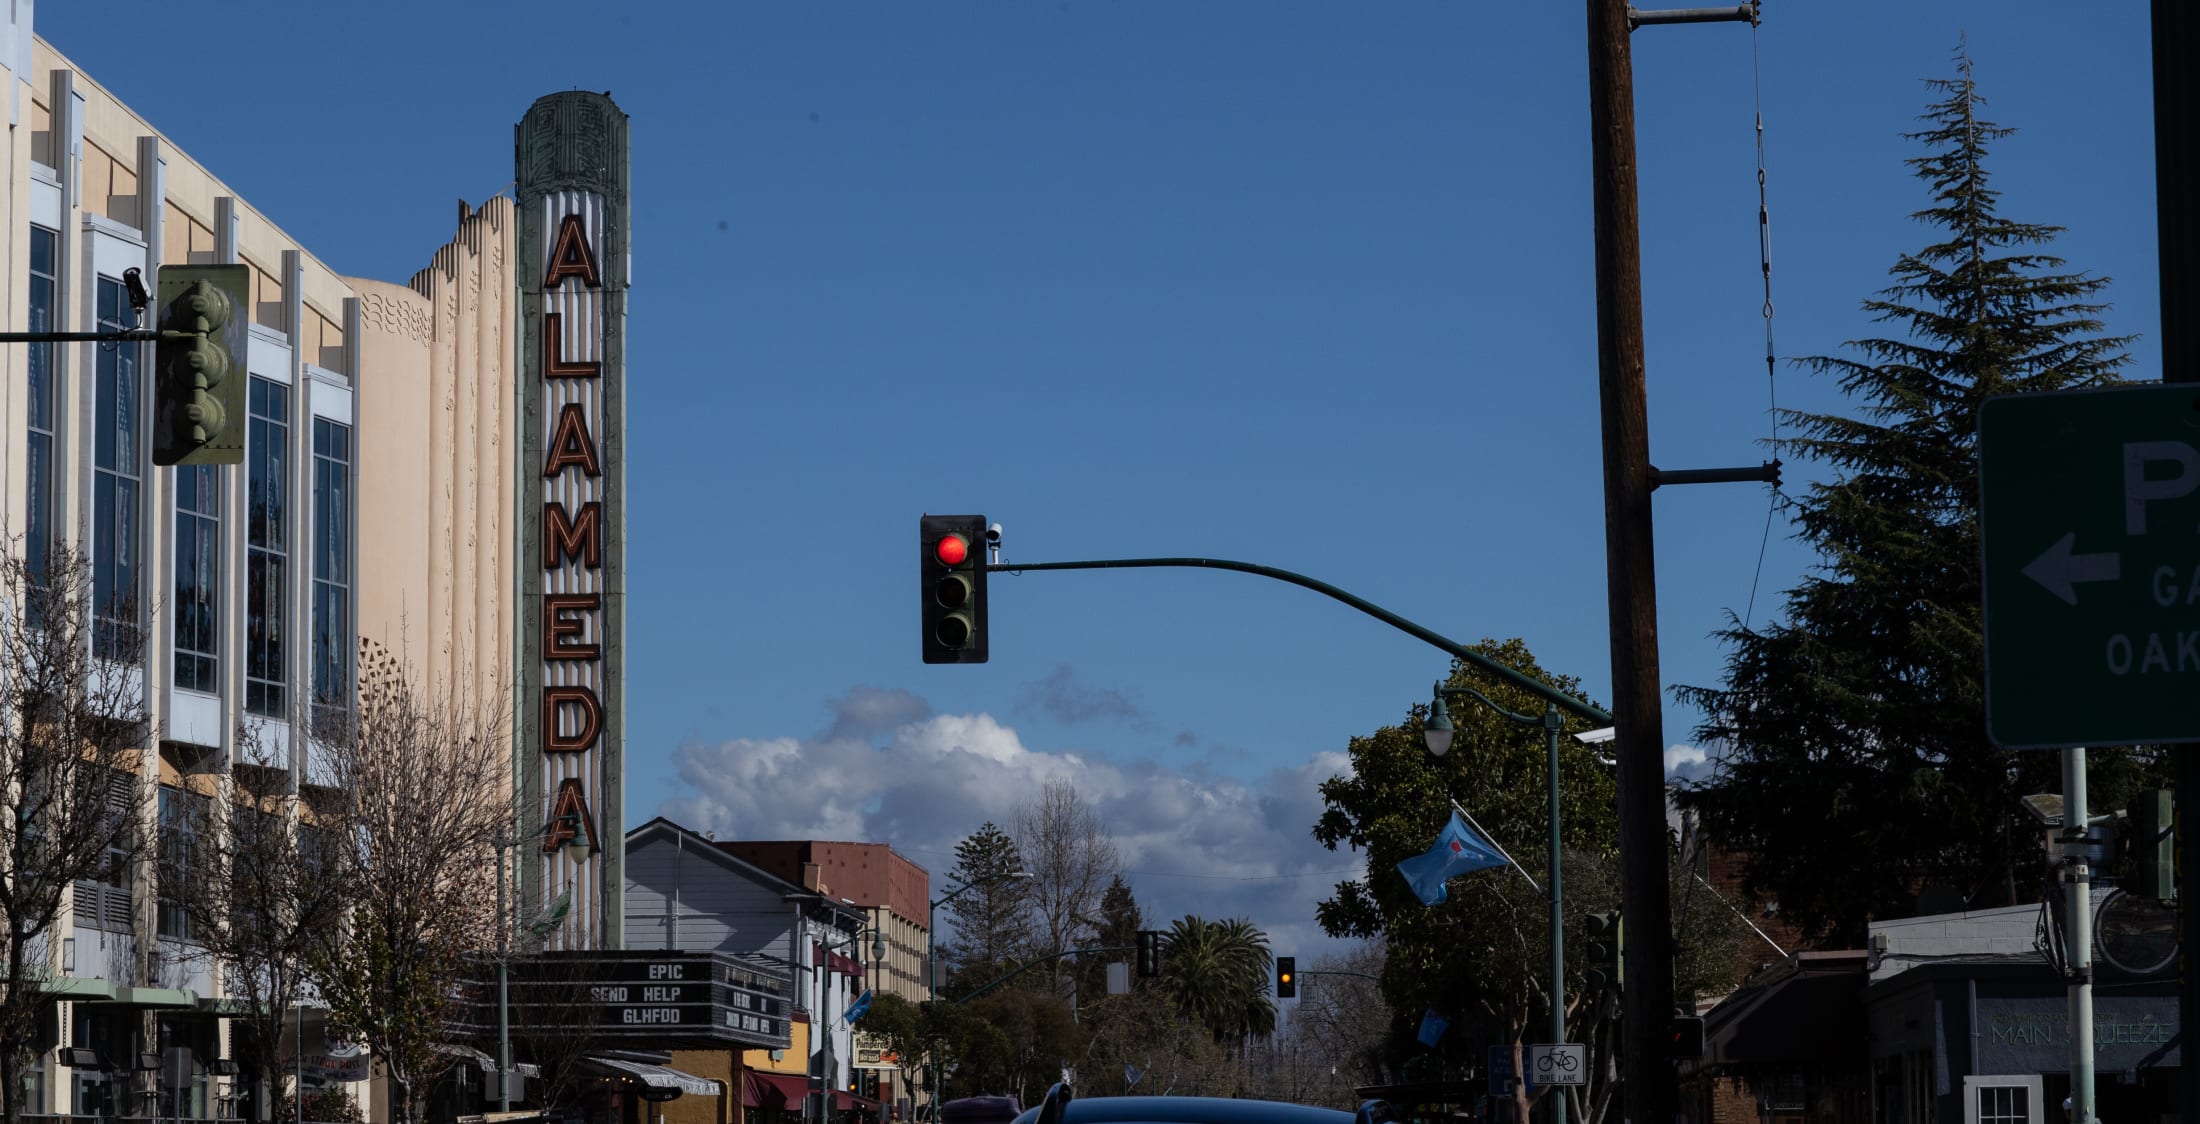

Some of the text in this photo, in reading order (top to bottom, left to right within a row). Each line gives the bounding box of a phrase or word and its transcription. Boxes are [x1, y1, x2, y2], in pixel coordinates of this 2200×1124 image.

[2122, 440, 2200, 536] P
[544, 214, 602, 854] ALAMEDA
[648, 964, 683, 980] EPIC
[591, 986, 681, 1002] SEND HELP
[623, 1008, 680, 1024] GLHFDD
[1991, 1021, 2051, 1046] MAIN
[1539, 1074, 1577, 1082] BIKE LANE
